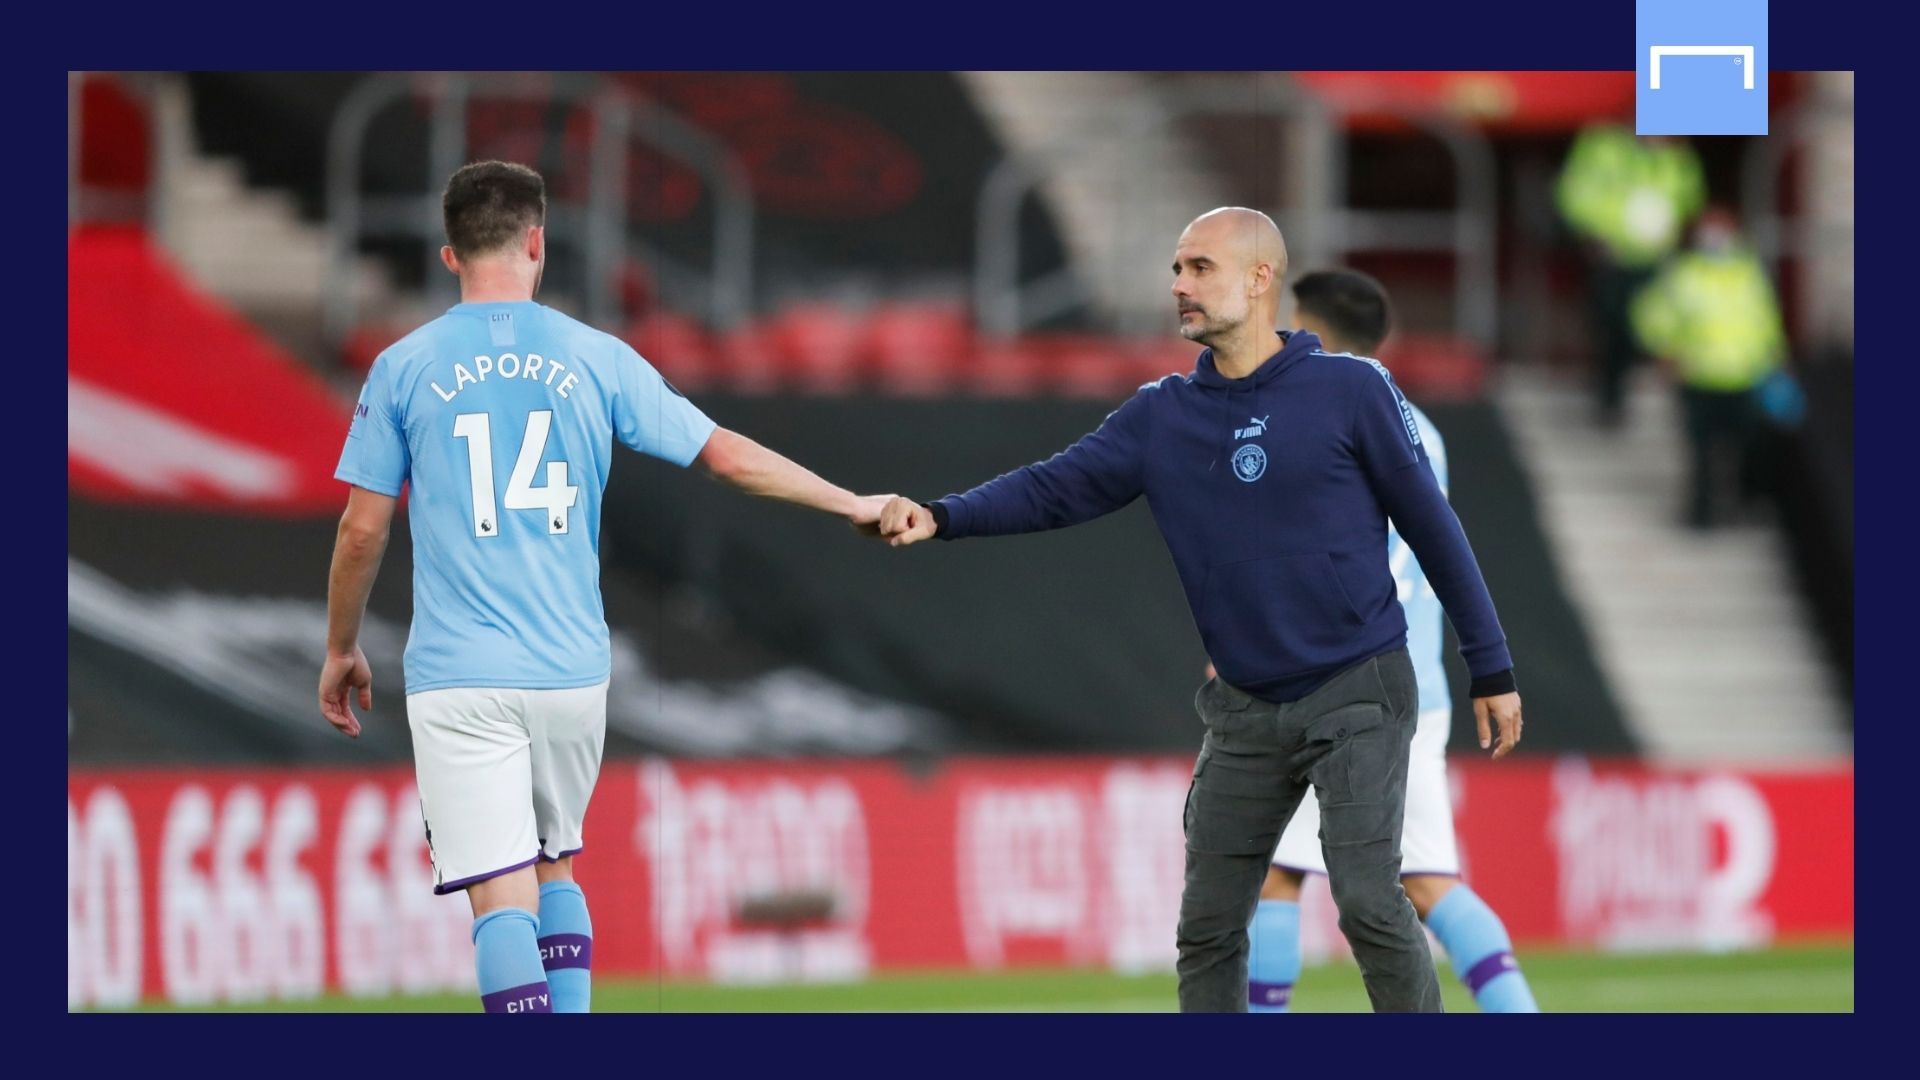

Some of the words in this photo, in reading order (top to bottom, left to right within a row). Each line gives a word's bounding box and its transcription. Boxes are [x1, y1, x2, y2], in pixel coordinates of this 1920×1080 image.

[491, 312, 511, 322] CITY
[431, 353, 580, 402] LAPORTE
[1400, 399, 1421, 446] PUMA
[453, 409, 579, 538] 14
[540, 945, 582, 961] CITY
[506, 993, 549, 1014] CITY
